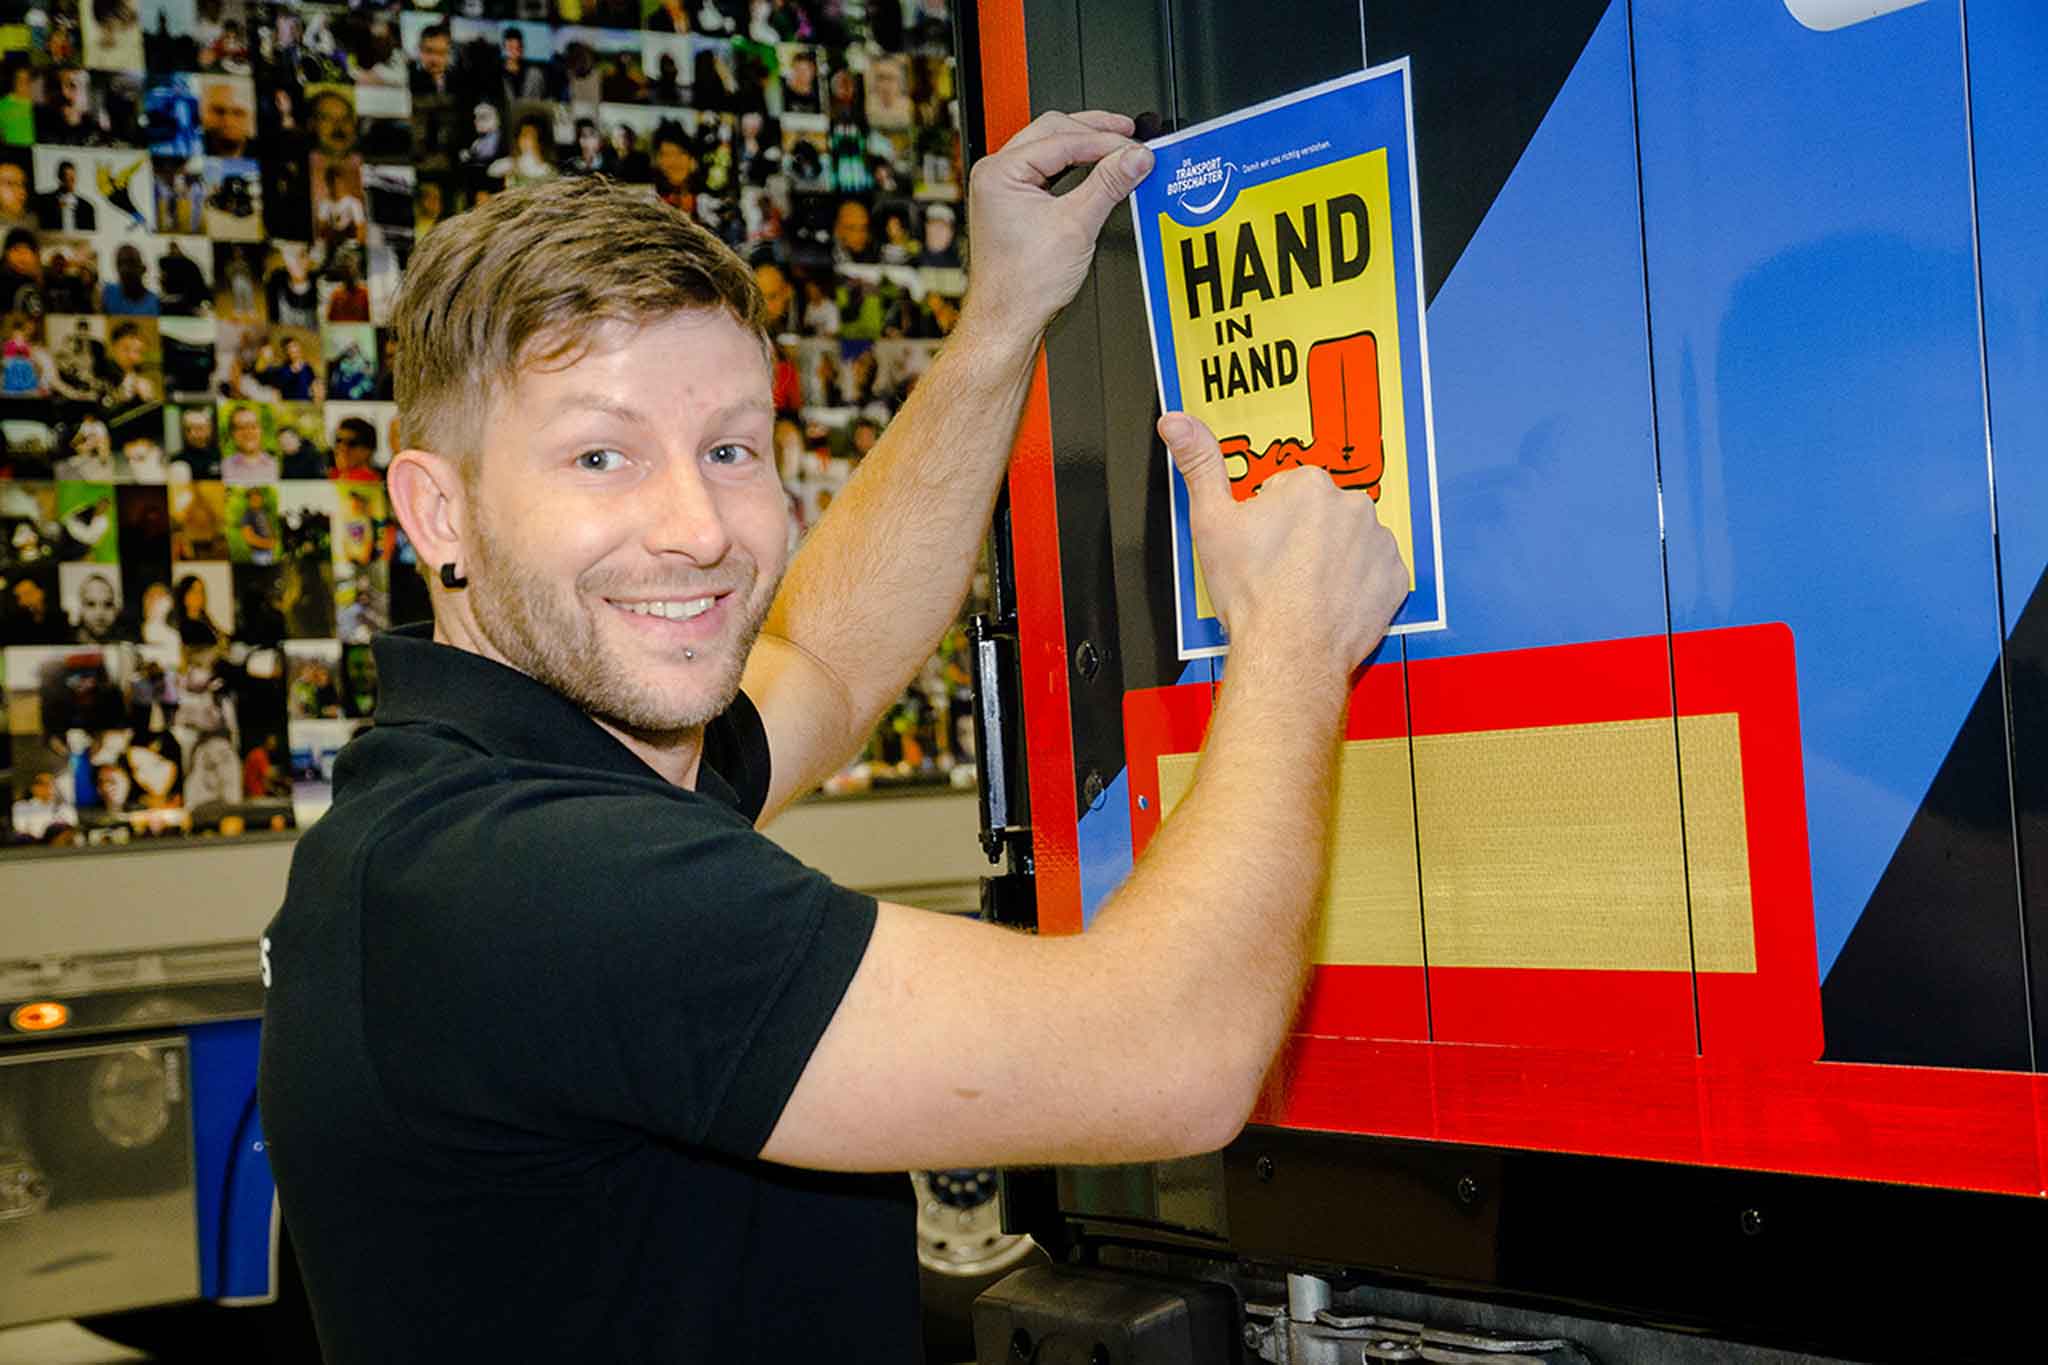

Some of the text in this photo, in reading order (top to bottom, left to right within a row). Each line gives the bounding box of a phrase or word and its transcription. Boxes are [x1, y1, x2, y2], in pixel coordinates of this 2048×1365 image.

[1167, 170, 1224, 196] BOTSCHAFTER
[1176, 156, 1222, 180] TRANSPORT
[1180, 193, 1371, 320] HAND
[1215, 314, 1254, 346] IN
[1201, 338, 1299, 403] HAND
